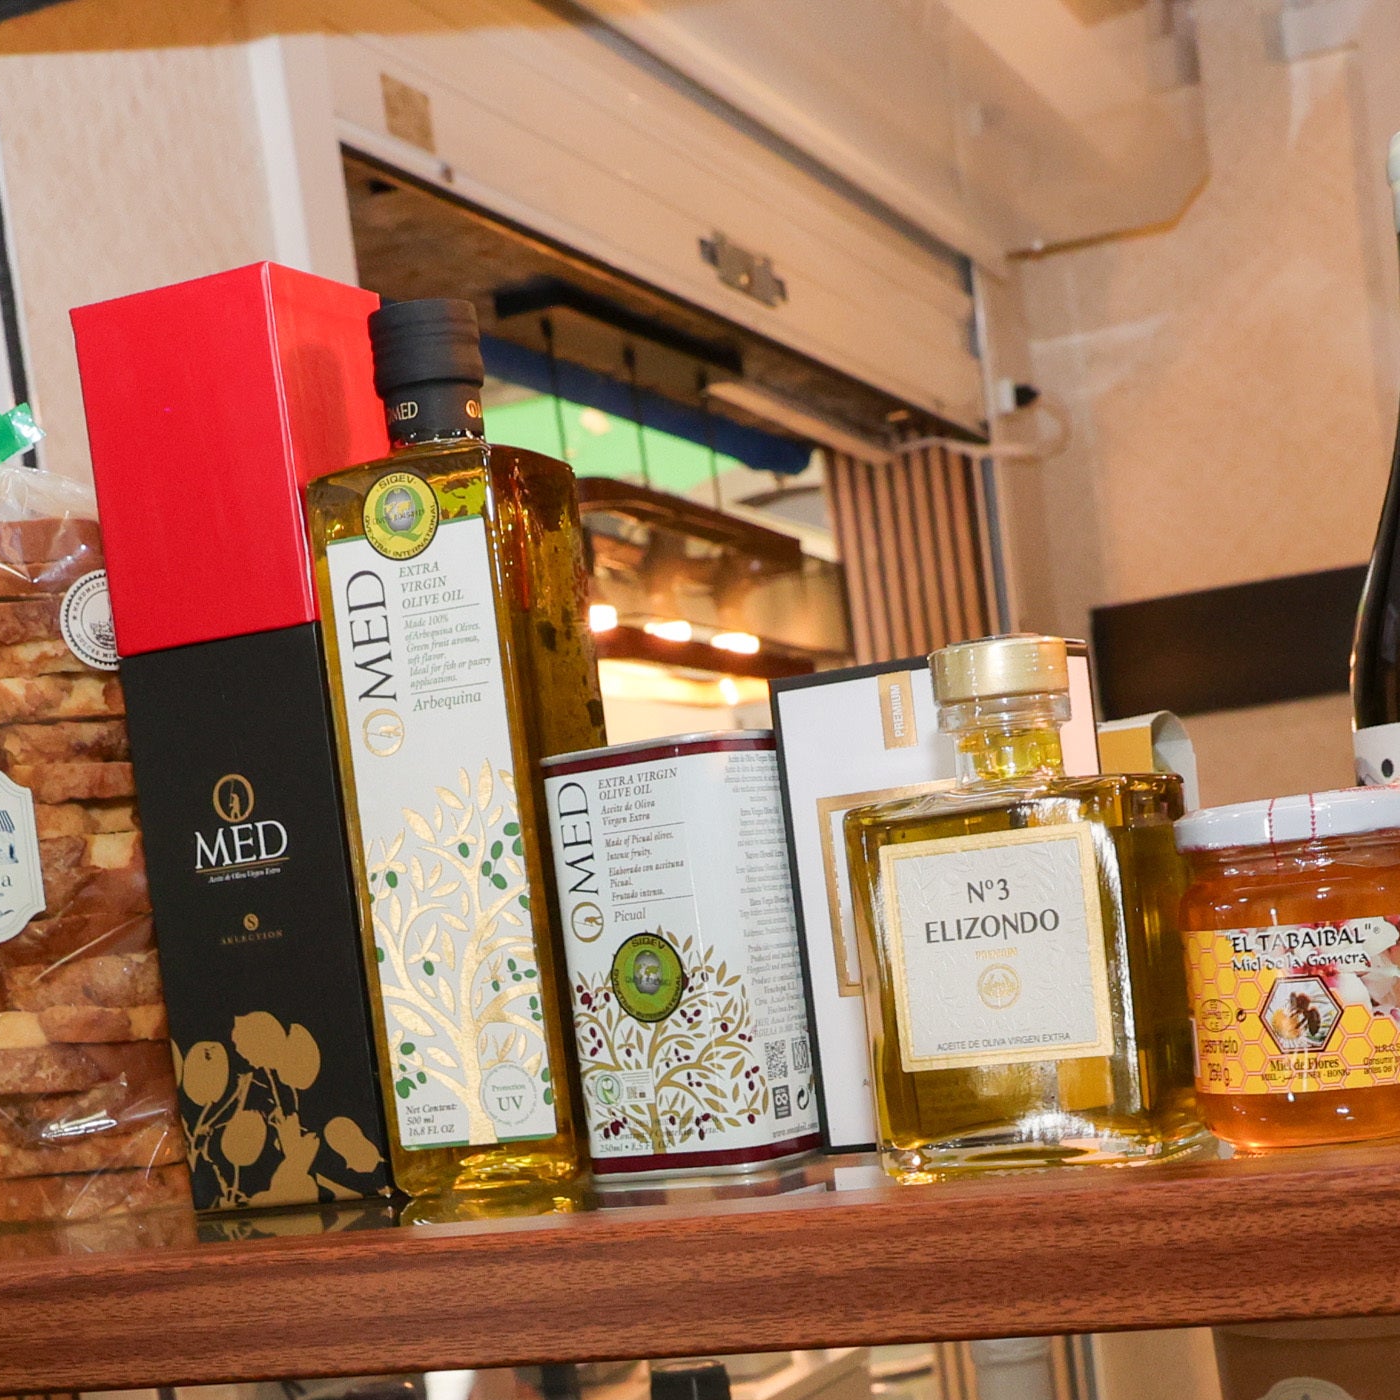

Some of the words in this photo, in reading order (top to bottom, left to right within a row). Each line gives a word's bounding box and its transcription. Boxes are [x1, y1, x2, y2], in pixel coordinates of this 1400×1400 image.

[399, 562, 440, 578] EXTRA
[401, 576, 447, 593] VIRGIN
[402, 594, 439, 609] OLIVE
[442, 590, 464, 601] OIL
[405, 619, 425, 629] Made
[428, 614, 448, 625] 100%
[406, 642, 429, 653] Green
[410, 666, 428, 676] Ideal
[413, 691, 481, 711] Arbequina
[893, 683, 905, 738] PREMIUM
[598, 774, 634, 789] EXTRA
[638, 768, 677, 781] VIRGIN
[600, 787, 631, 800] OLIVE
[634, 784, 651, 795] OIL
[601, 805, 623, 815] Aceite
[605, 838, 622, 848] Made
[632, 832, 652, 843] Picual
[614, 908, 646, 922] Picual
[925, 909, 1059, 943] ELIZONDO
[1232, 958, 1262, 973] Miel
[1265, 955, 1283, 970] de
[1286, 954, 1300, 969] la
[1306, 950, 1369, 967] Gomera
[937, 1040, 967, 1051] ACEITE
[982, 1038, 1006, 1048] OLIVA
[1008, 1035, 1040, 1045] VIRGEN
[1042, 1032, 1070, 1042] EXTRA
[1270, 1060, 1292, 1072] Miel
[1308, 1058, 1339, 1069] Flores
[406, 1105, 420, 1115] Net
[497, 1096, 523, 1112] UV
[407, 1116, 421, 1126] 500
